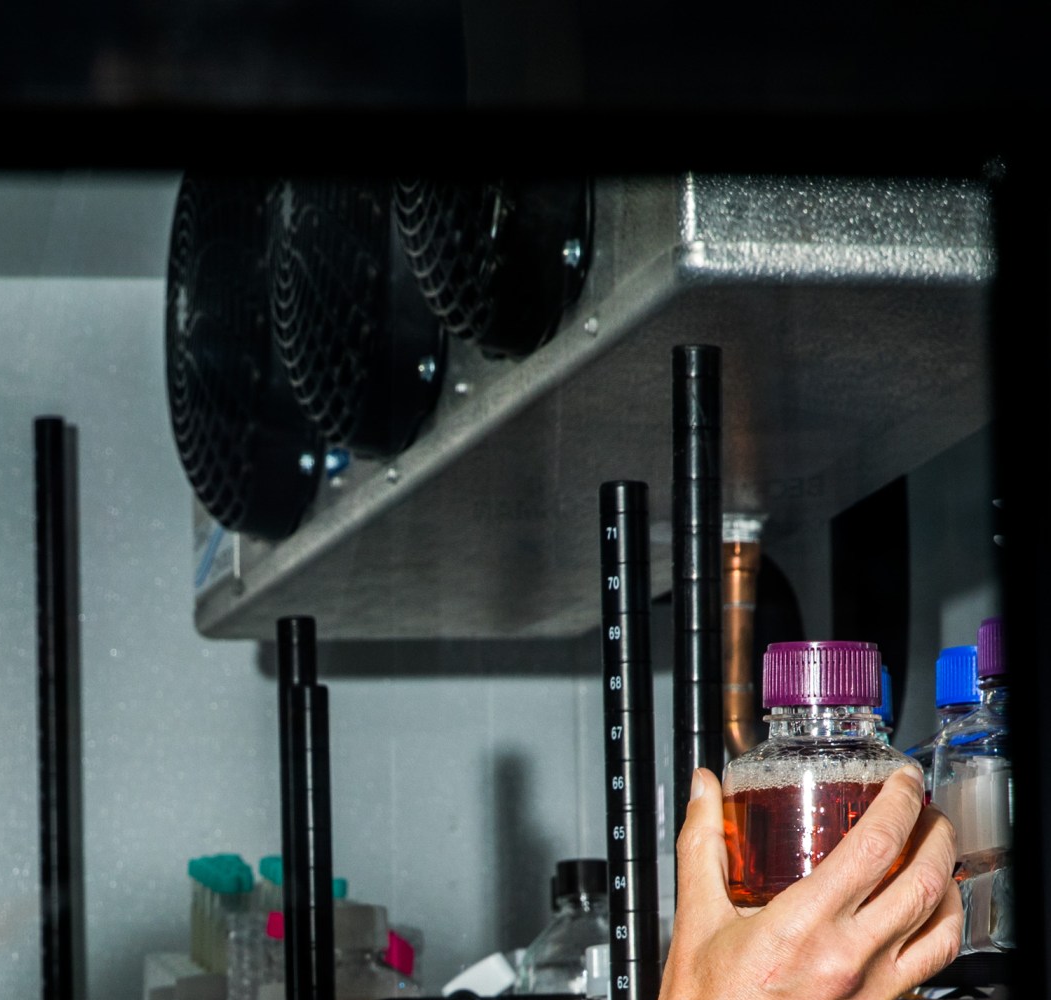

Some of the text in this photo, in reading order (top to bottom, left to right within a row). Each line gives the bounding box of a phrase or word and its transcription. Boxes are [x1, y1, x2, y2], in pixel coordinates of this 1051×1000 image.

[606, 527, 618, 540] 71
[607, 576, 620, 590] 70
[608, 626, 621, 640] 69
[609, 676, 622, 690] 68
[610, 726, 623, 740] 67
[612, 776, 624, 790] 66
[613, 826, 626, 840] 65
[614, 876, 626, 890] 64
[615, 926, 628, 940] 63
[617, 976, 629, 989] 62
